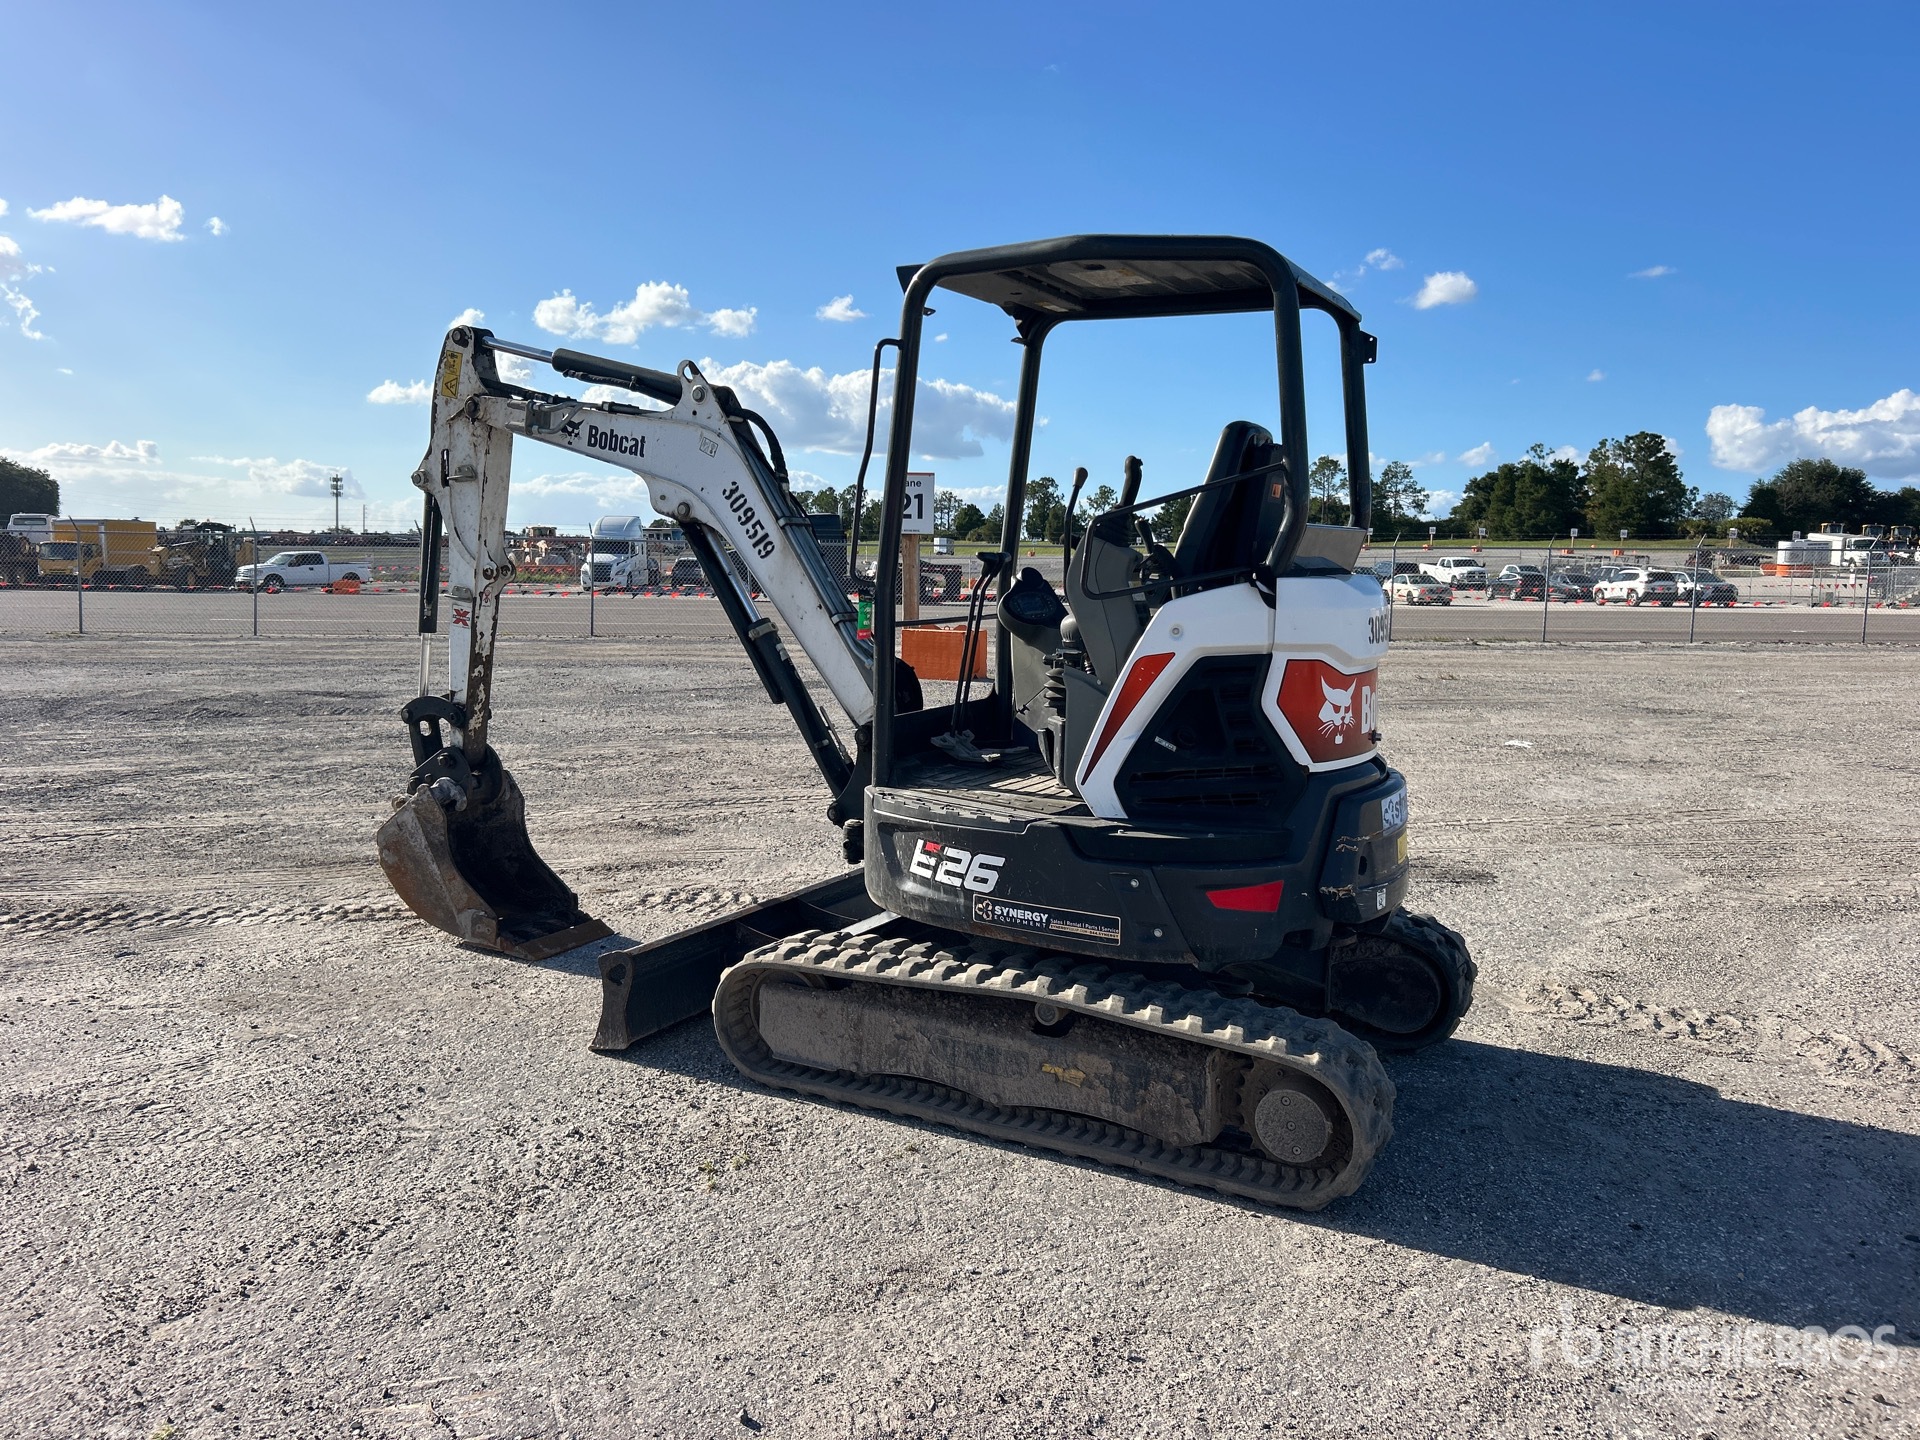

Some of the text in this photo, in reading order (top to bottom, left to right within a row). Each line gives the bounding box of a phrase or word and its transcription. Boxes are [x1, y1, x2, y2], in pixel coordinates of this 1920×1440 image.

[587, 424, 647, 458] Bobcat
[722, 481, 775, 559] 309519
[902, 493, 924, 520] 21
[909, 838, 1006, 893] E26
[994, 905, 1049, 923] SYNERGY
[994, 914, 1047, 929] EQUIPMENT
